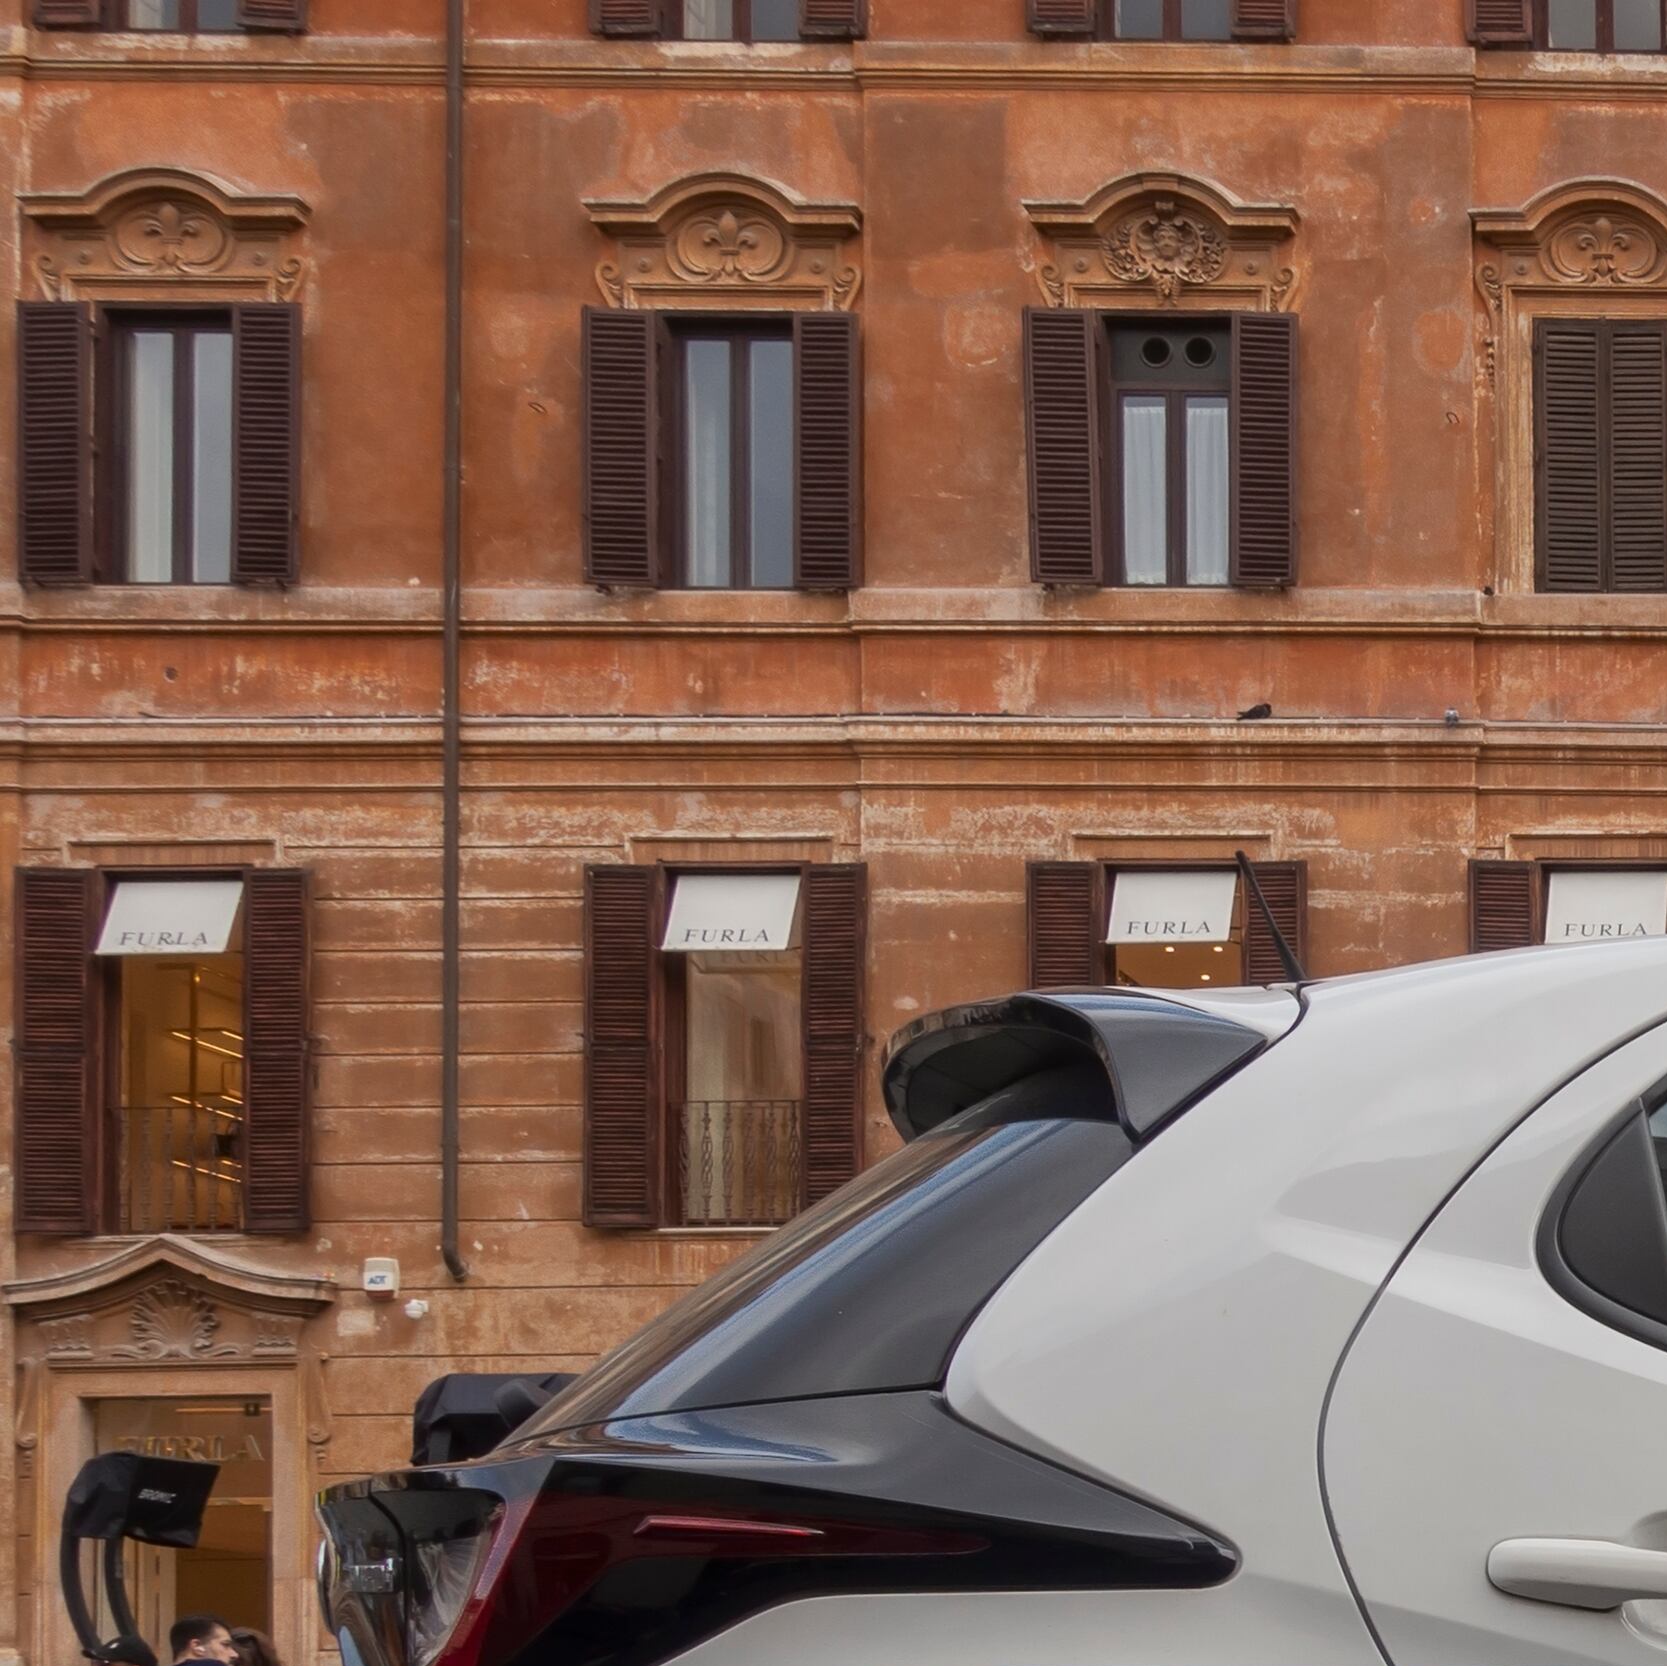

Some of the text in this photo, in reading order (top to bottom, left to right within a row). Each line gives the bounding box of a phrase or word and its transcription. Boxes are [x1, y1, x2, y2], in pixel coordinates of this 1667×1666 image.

[684, 928, 769, 942] FURLA
[1127, 920, 1211, 935] FURLA
[1564, 922, 1647, 937] FURLA
[119, 931, 208, 946] FURLA
